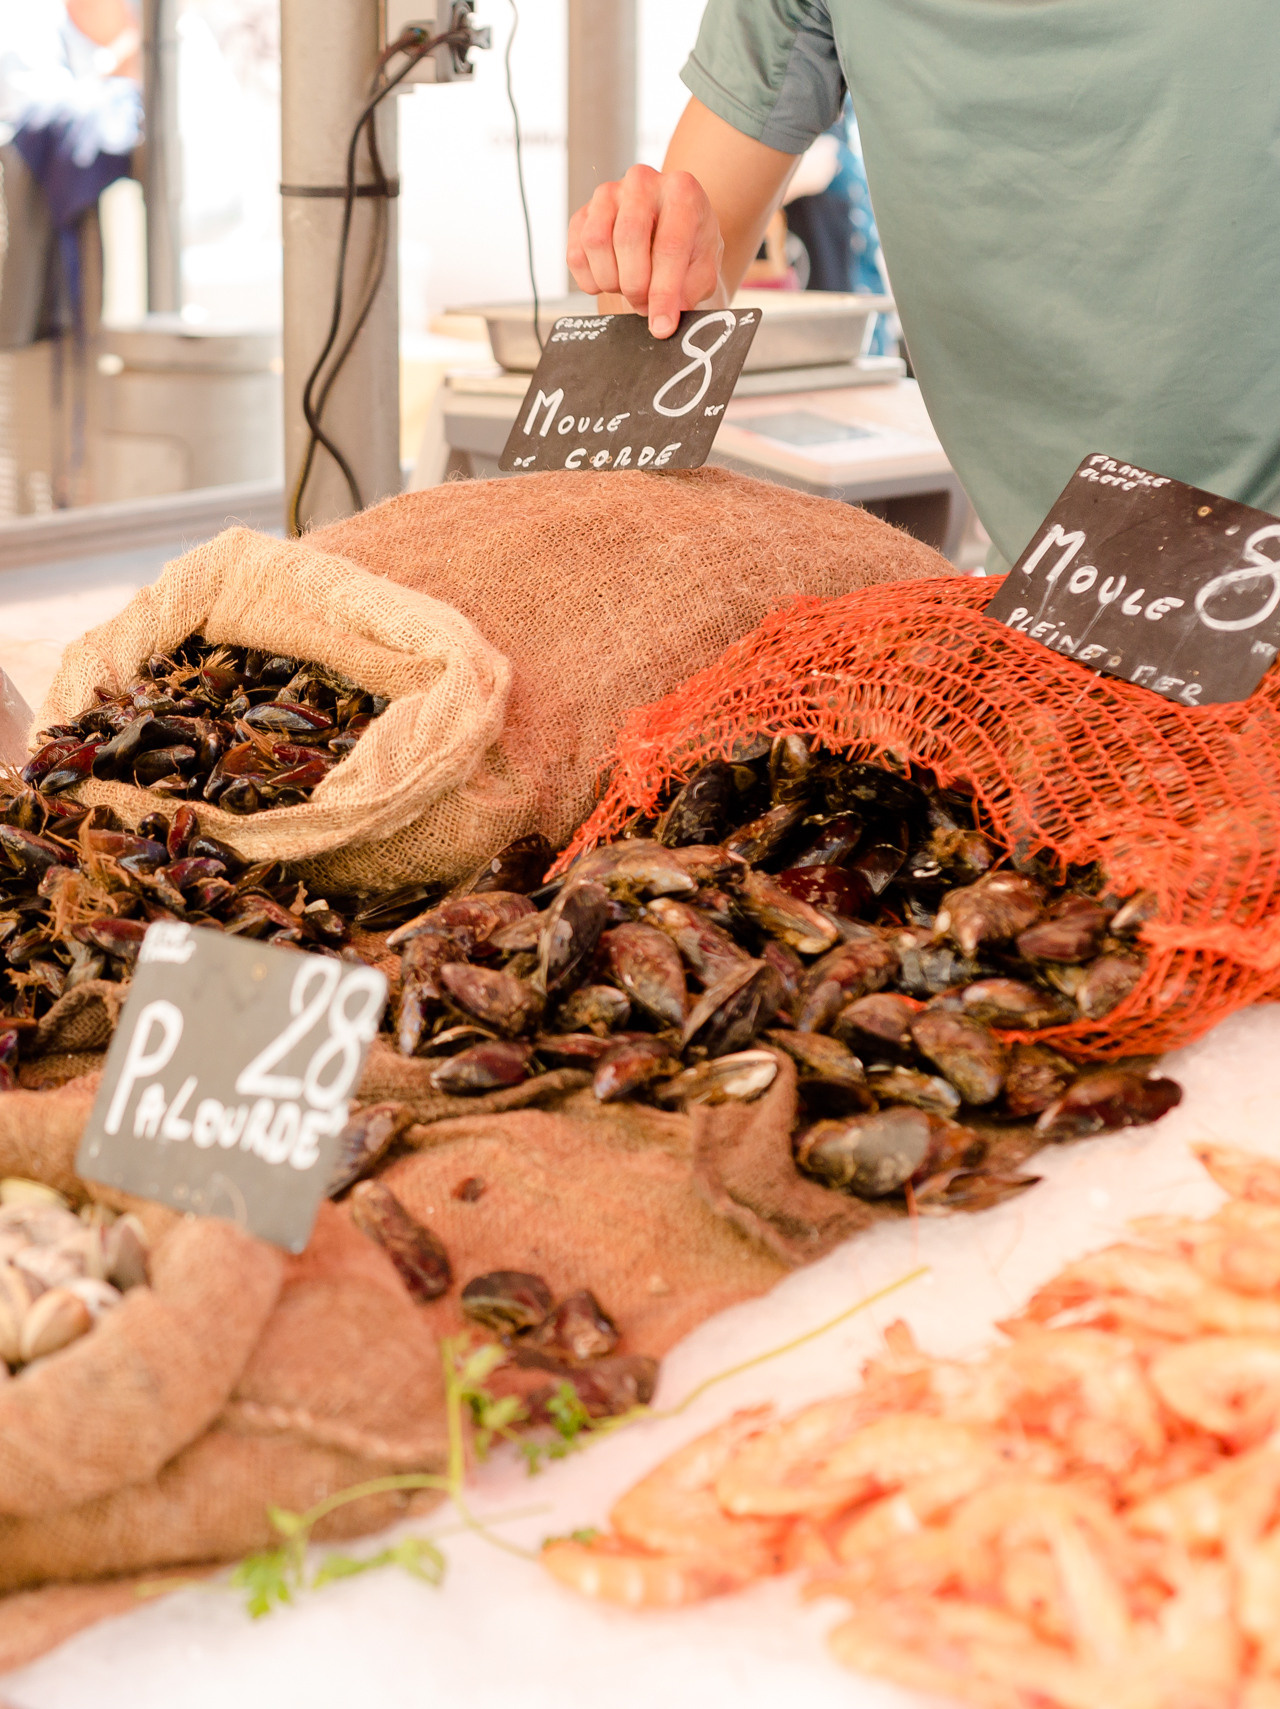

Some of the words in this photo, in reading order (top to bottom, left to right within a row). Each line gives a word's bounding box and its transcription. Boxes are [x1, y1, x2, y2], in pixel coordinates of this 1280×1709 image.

[653, 310, 736, 417] 8
[523, 388, 630, 437] MOULE
[564, 443, 681, 469] CORDE
[1089, 455, 1171, 488] FRANCE
[1022, 524, 1185, 620] MOULE
[1004, 607, 1108, 660] PLEINE
[235, 955, 388, 1110] 28
[104, 1000, 324, 1170] PALOURDE
